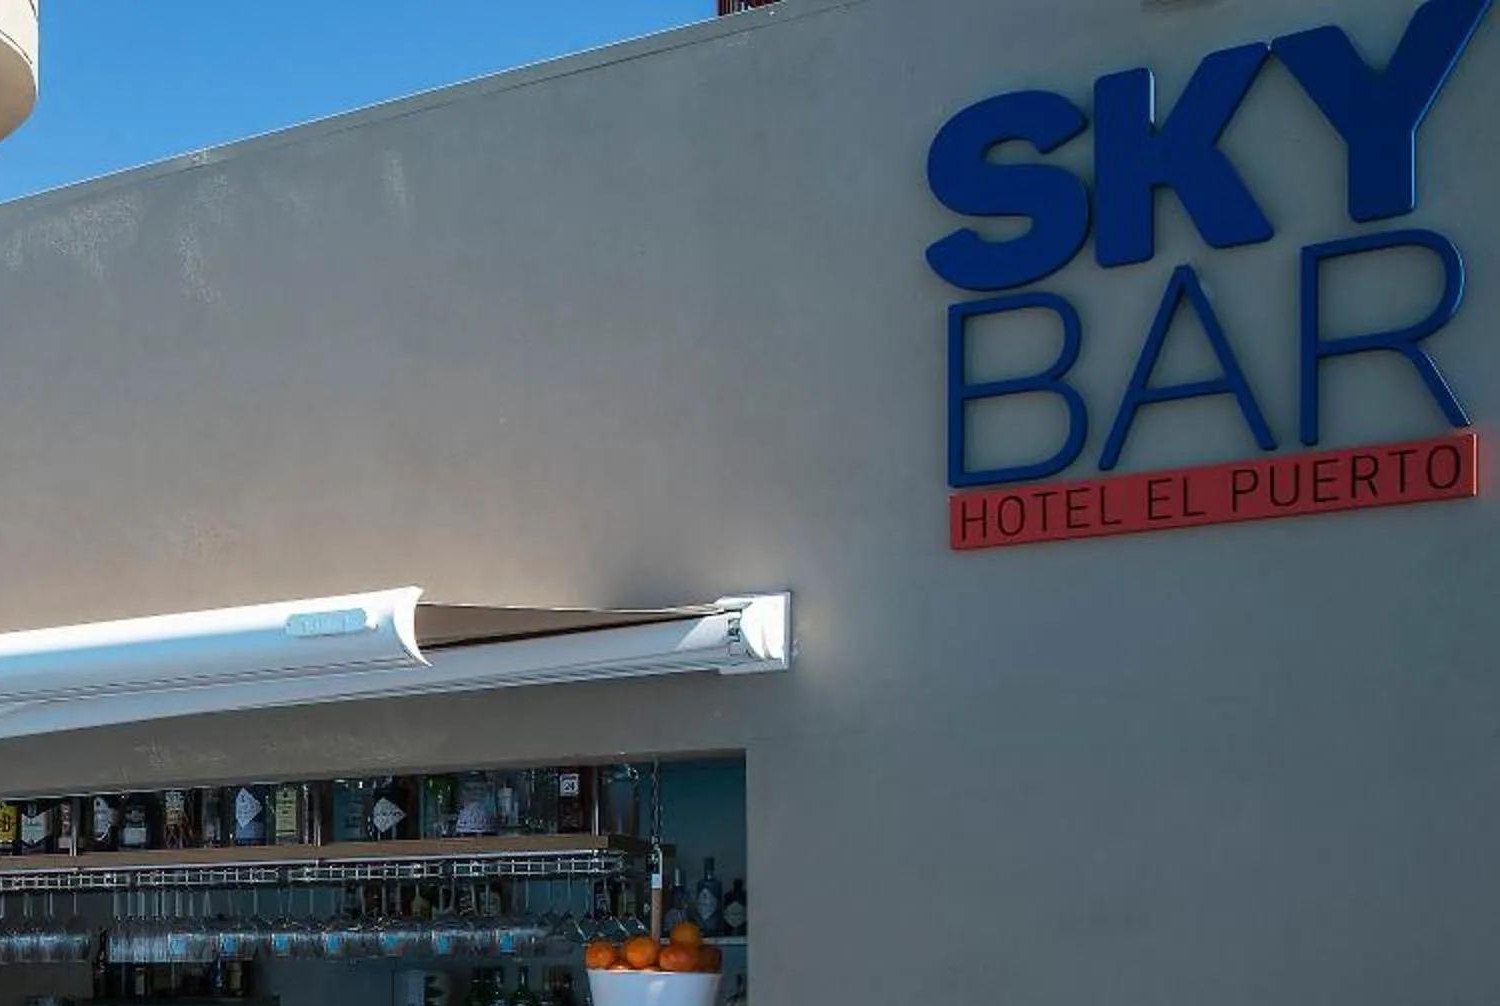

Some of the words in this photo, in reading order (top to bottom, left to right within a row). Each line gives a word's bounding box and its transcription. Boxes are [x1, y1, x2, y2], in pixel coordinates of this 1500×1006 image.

[925, 0, 1494, 292] SKY
[947, 226, 1472, 488] BAR
[959, 482, 1122, 542] HOTEL
[1146, 476, 1205, 521] EL
[1230, 443, 1462, 513] PUERTO
